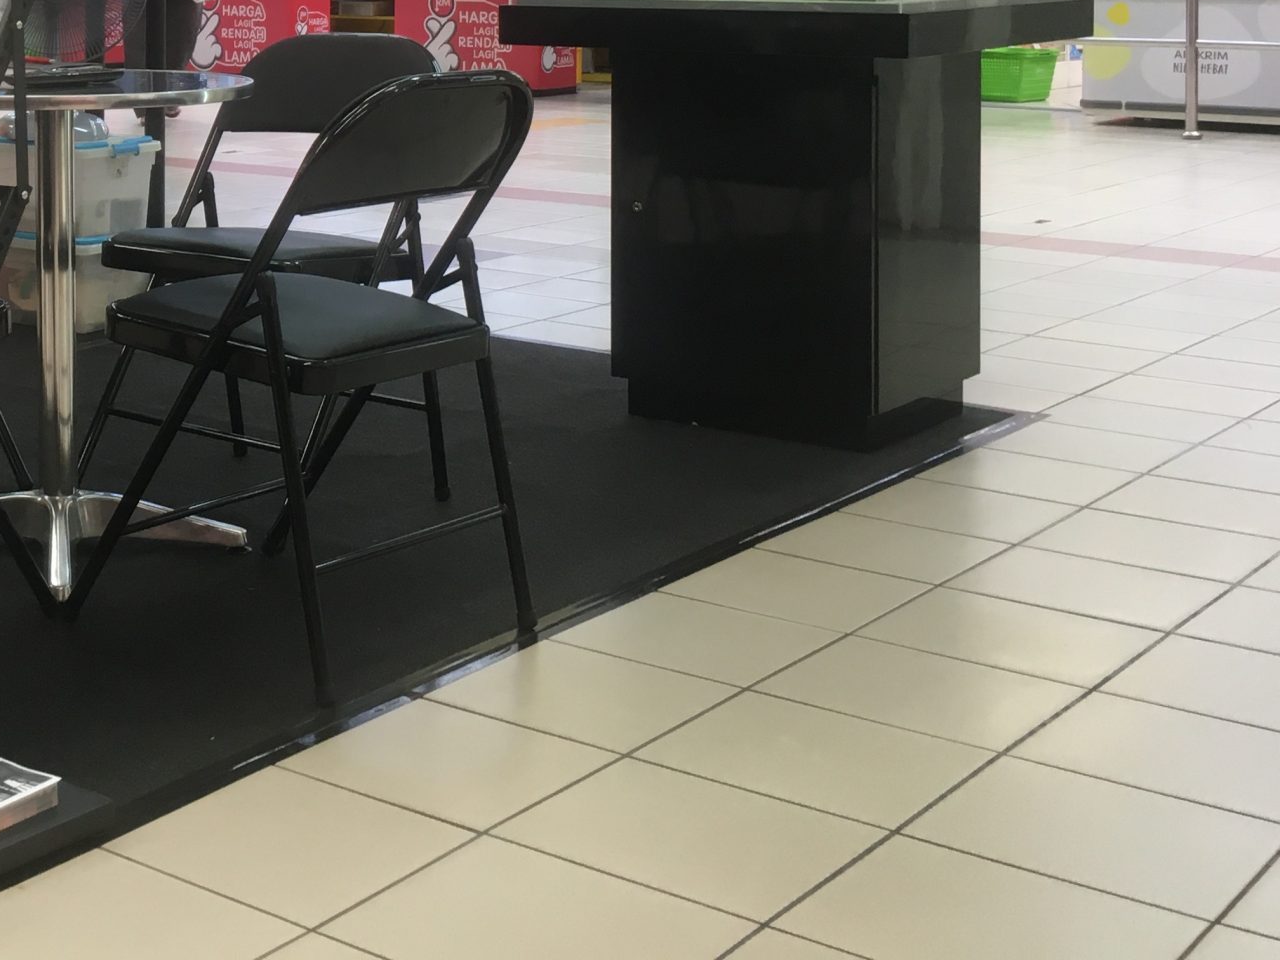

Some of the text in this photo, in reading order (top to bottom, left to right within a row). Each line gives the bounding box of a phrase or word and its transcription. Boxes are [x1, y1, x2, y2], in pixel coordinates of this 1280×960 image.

[222, 5, 263, 17] HARGA
[459, 10, 498, 24] HARG
[234, 19, 253, 28] LAGI
[221, 28, 265, 40] RENDAH
[473, 26, 495, 36] LAGI
[233, 41, 253, 49] LAGI
[473, 49, 495, 59] LAGI
[1200, 63, 1228, 75] HEBAT
